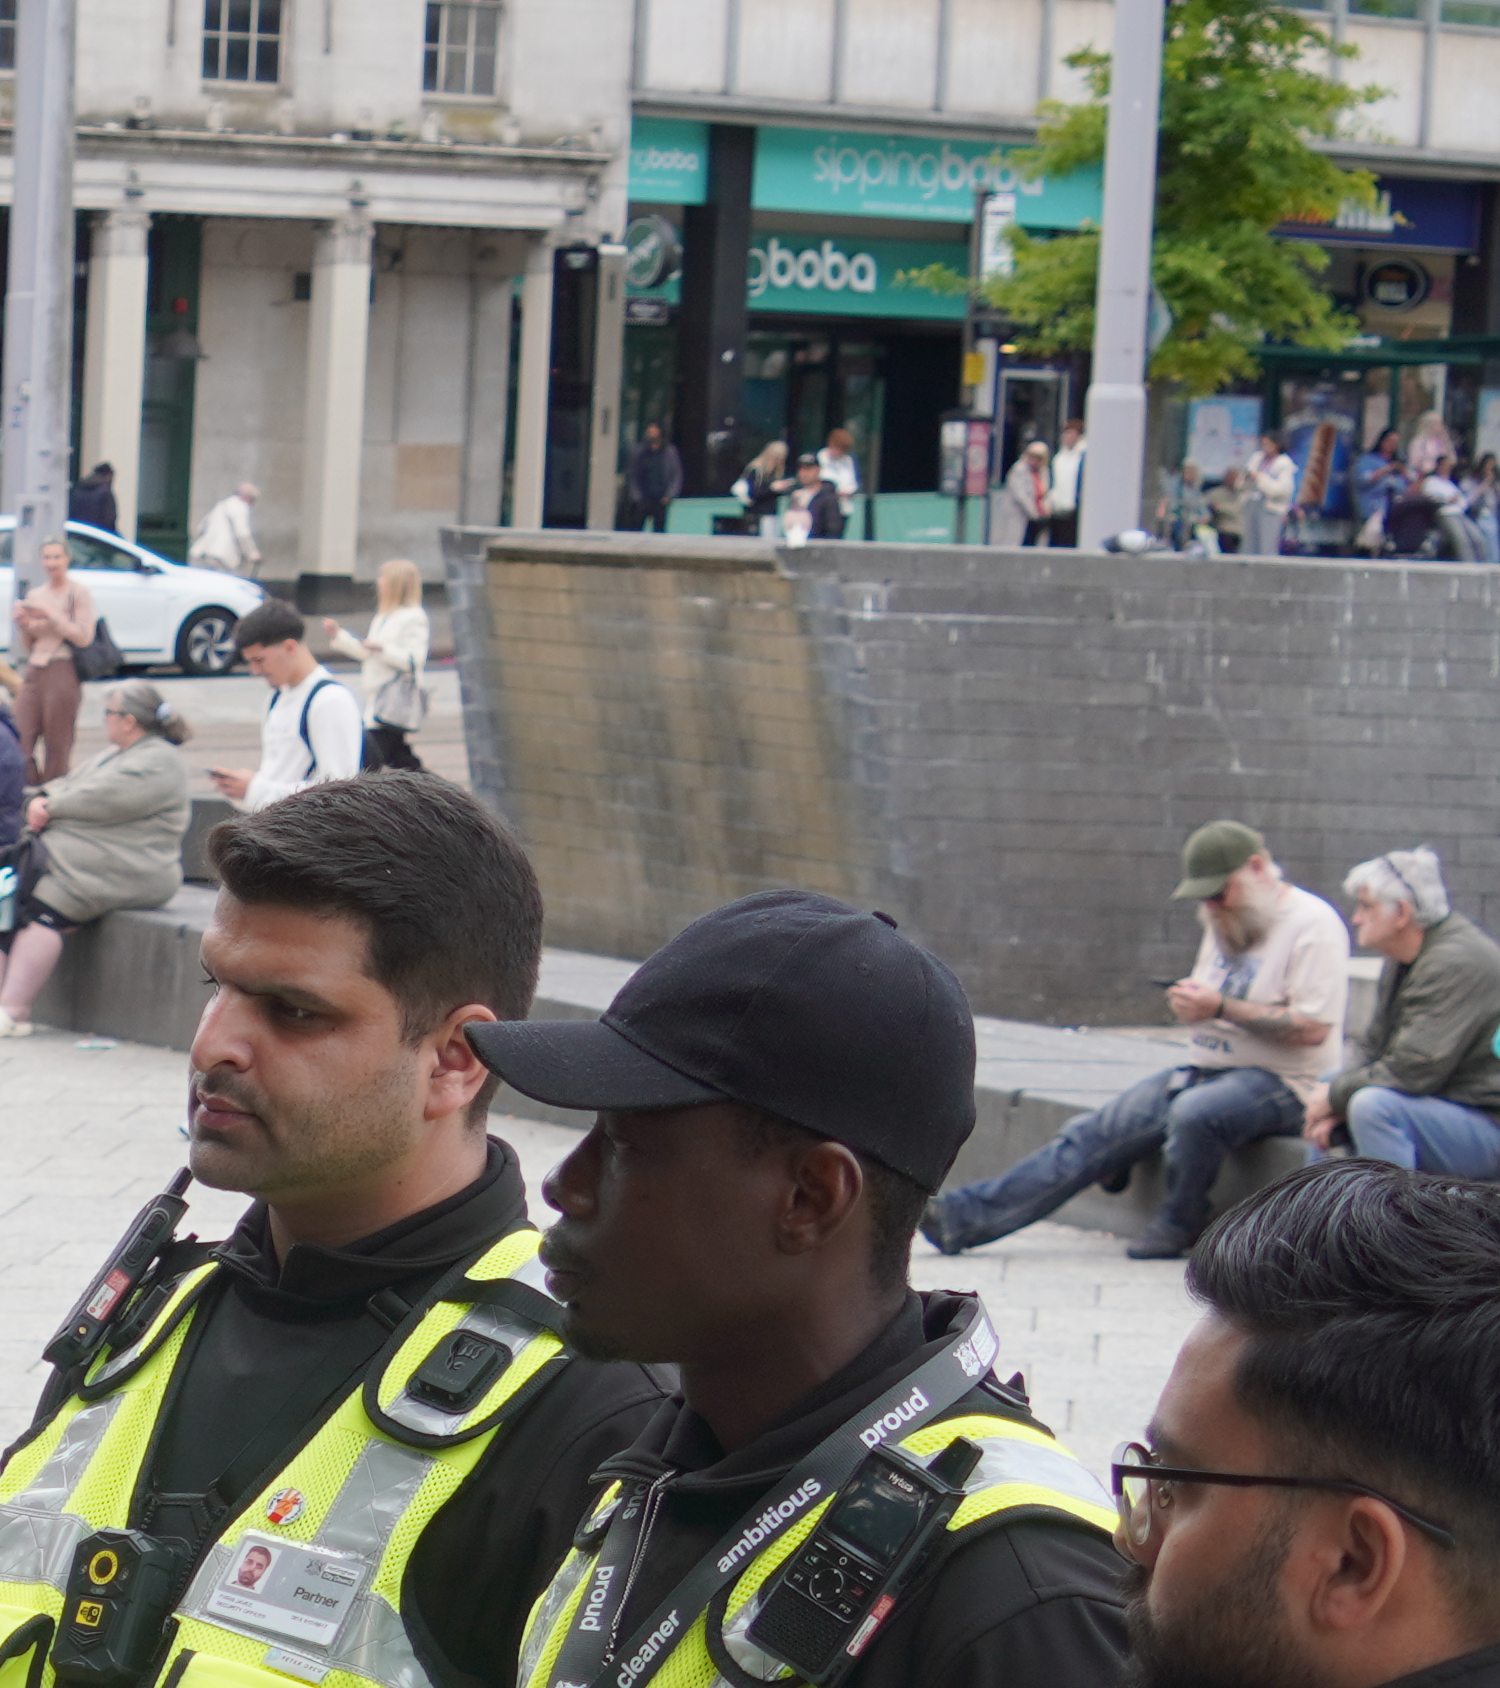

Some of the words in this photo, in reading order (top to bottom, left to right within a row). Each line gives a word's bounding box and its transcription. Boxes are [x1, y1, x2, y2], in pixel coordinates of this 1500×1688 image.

[858, 1386, 930, 1450] proud
[716, 1477, 822, 1573] ambitious
[293, 1587, 340, 1610] Partner
[578, 1565, 616, 1632] proud
